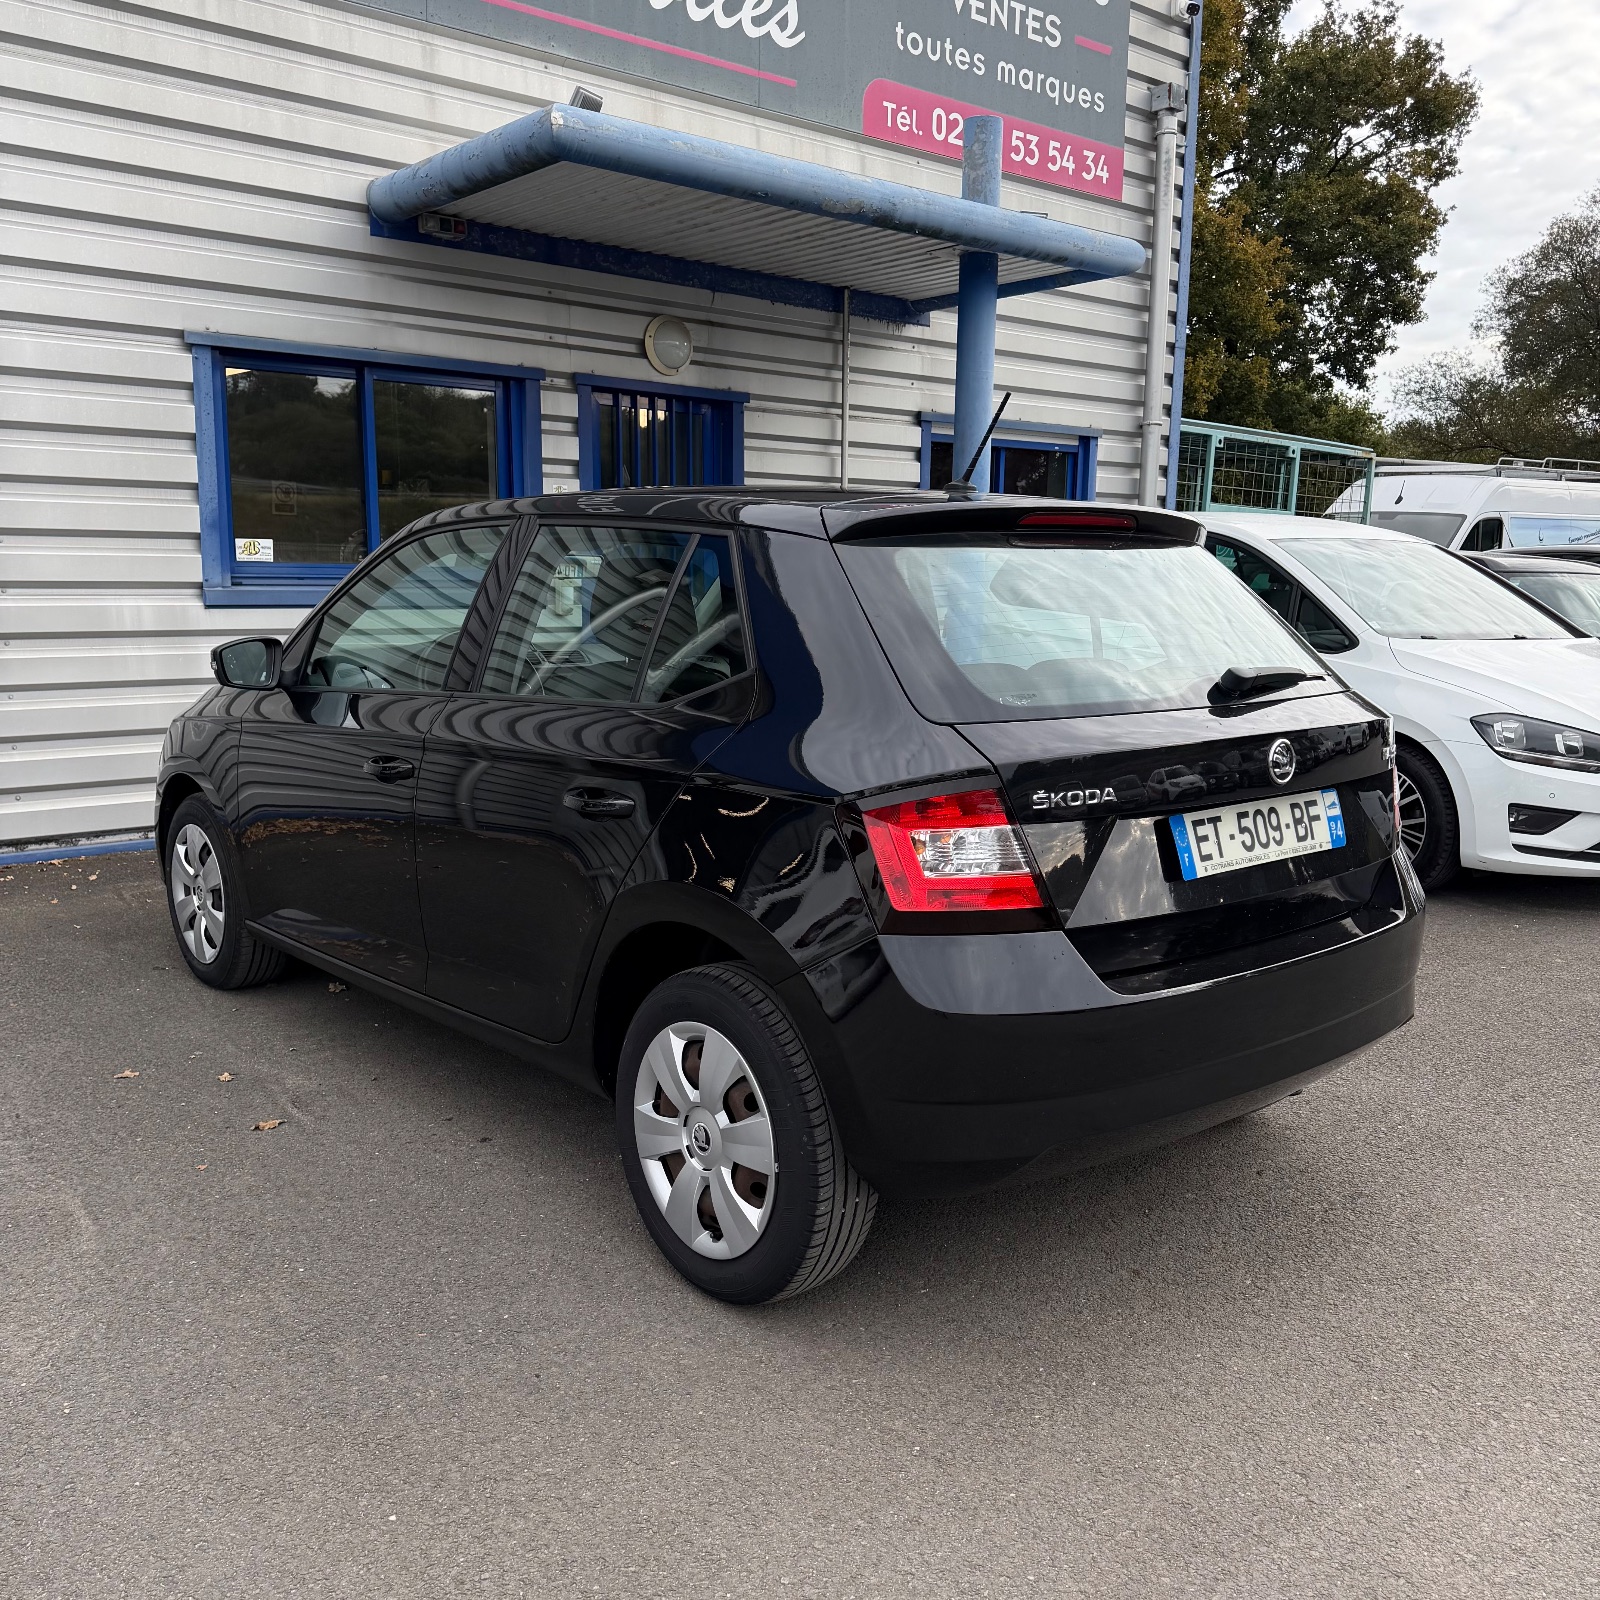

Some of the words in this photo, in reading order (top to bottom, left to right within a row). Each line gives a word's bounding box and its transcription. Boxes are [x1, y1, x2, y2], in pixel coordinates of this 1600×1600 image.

[896, 21, 986, 76] toutes
[997, 60, 1105, 113] marques
[883, 100, 923, 136] Tél.
[932, 107, 963, 146] 02
[1010, 129, 1040, 166] 53
[1048, 140, 1076, 176] 54
[1082, 150, 1109, 184] 34
[1032, 787, 1118, 809] ŠKODA
[1183, 853, 1190, 867] F
